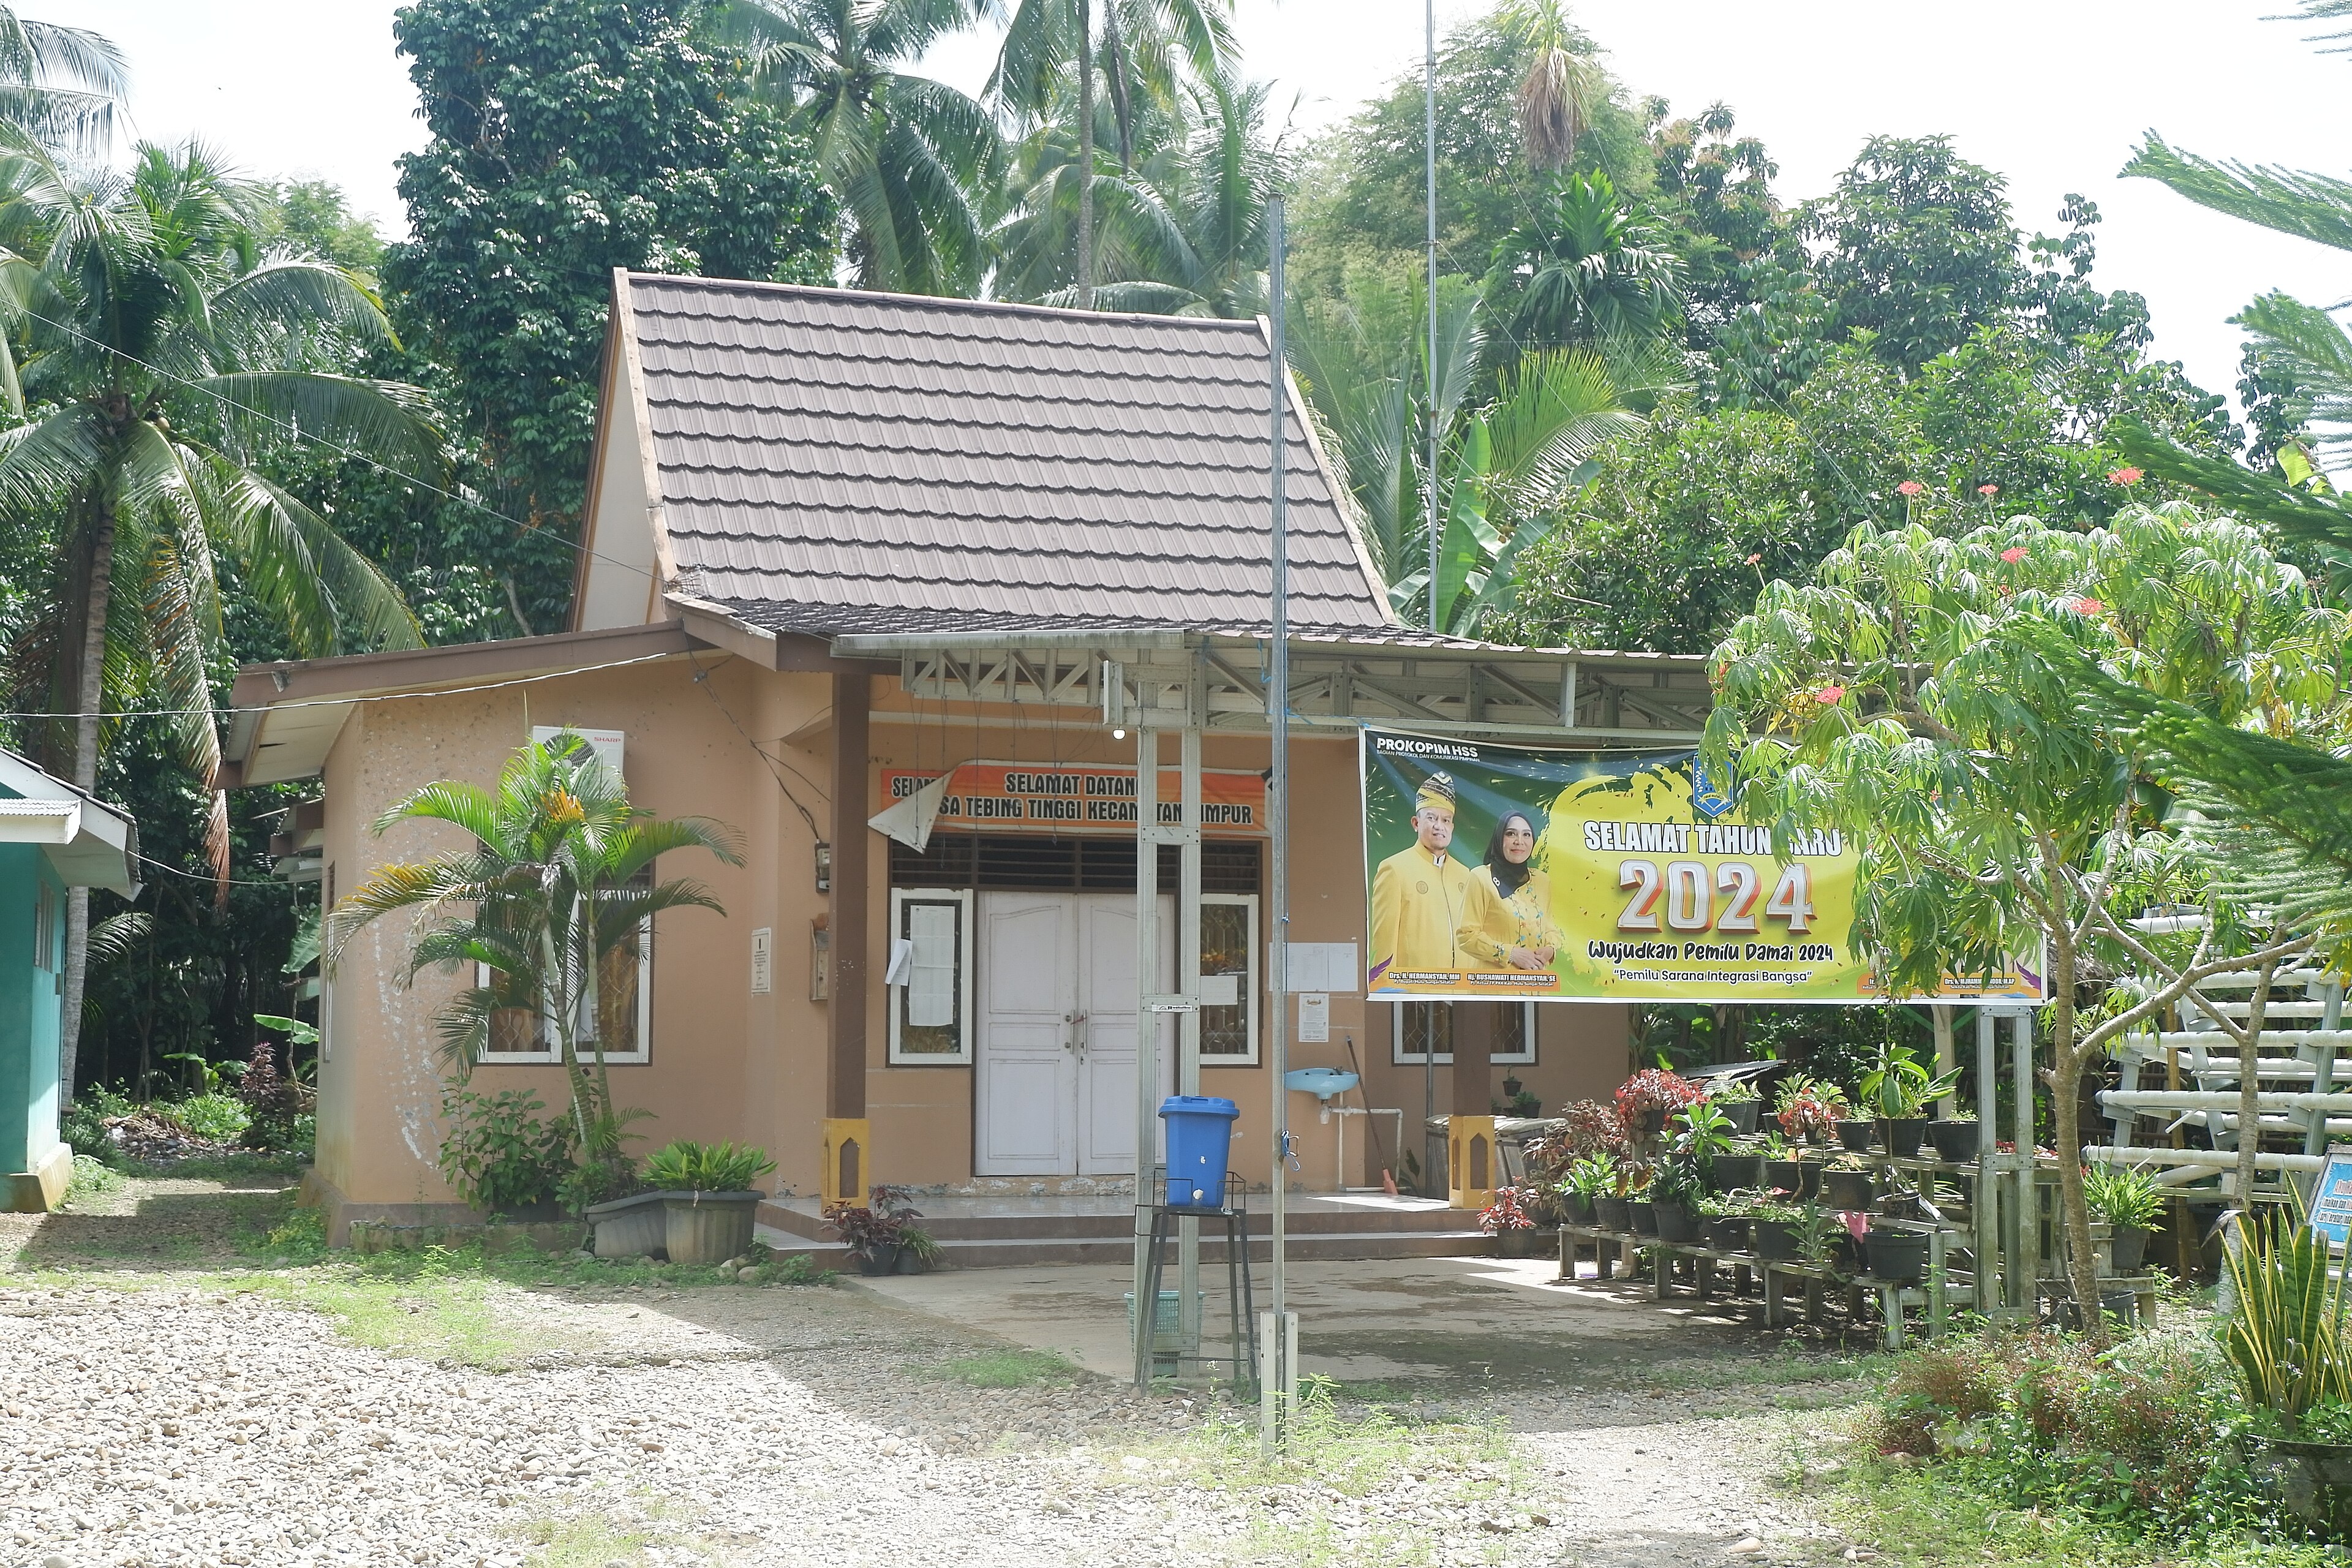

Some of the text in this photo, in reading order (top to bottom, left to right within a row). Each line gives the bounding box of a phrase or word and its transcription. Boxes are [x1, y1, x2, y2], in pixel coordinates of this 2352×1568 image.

[1376, 737, 1479, 758] PROKOPIM HSS
[1006, 773, 1138, 796] SELAMAT DATAN
[966, 797, 1023, 818] TEBING
[1028, 799, 1082, 820] TINGGI
[1201, 804, 1252, 824] IMPUR
[1583, 821, 1842, 856] SELAMAT TAHUN ARU
[1617, 859, 1818, 935] 2024
[1588, 940, 1834, 964] Wujudkan Pemilu Damai 2024
[1614, 968, 1812, 986] “Pemilu Sarana Integrasi Bangsa”
